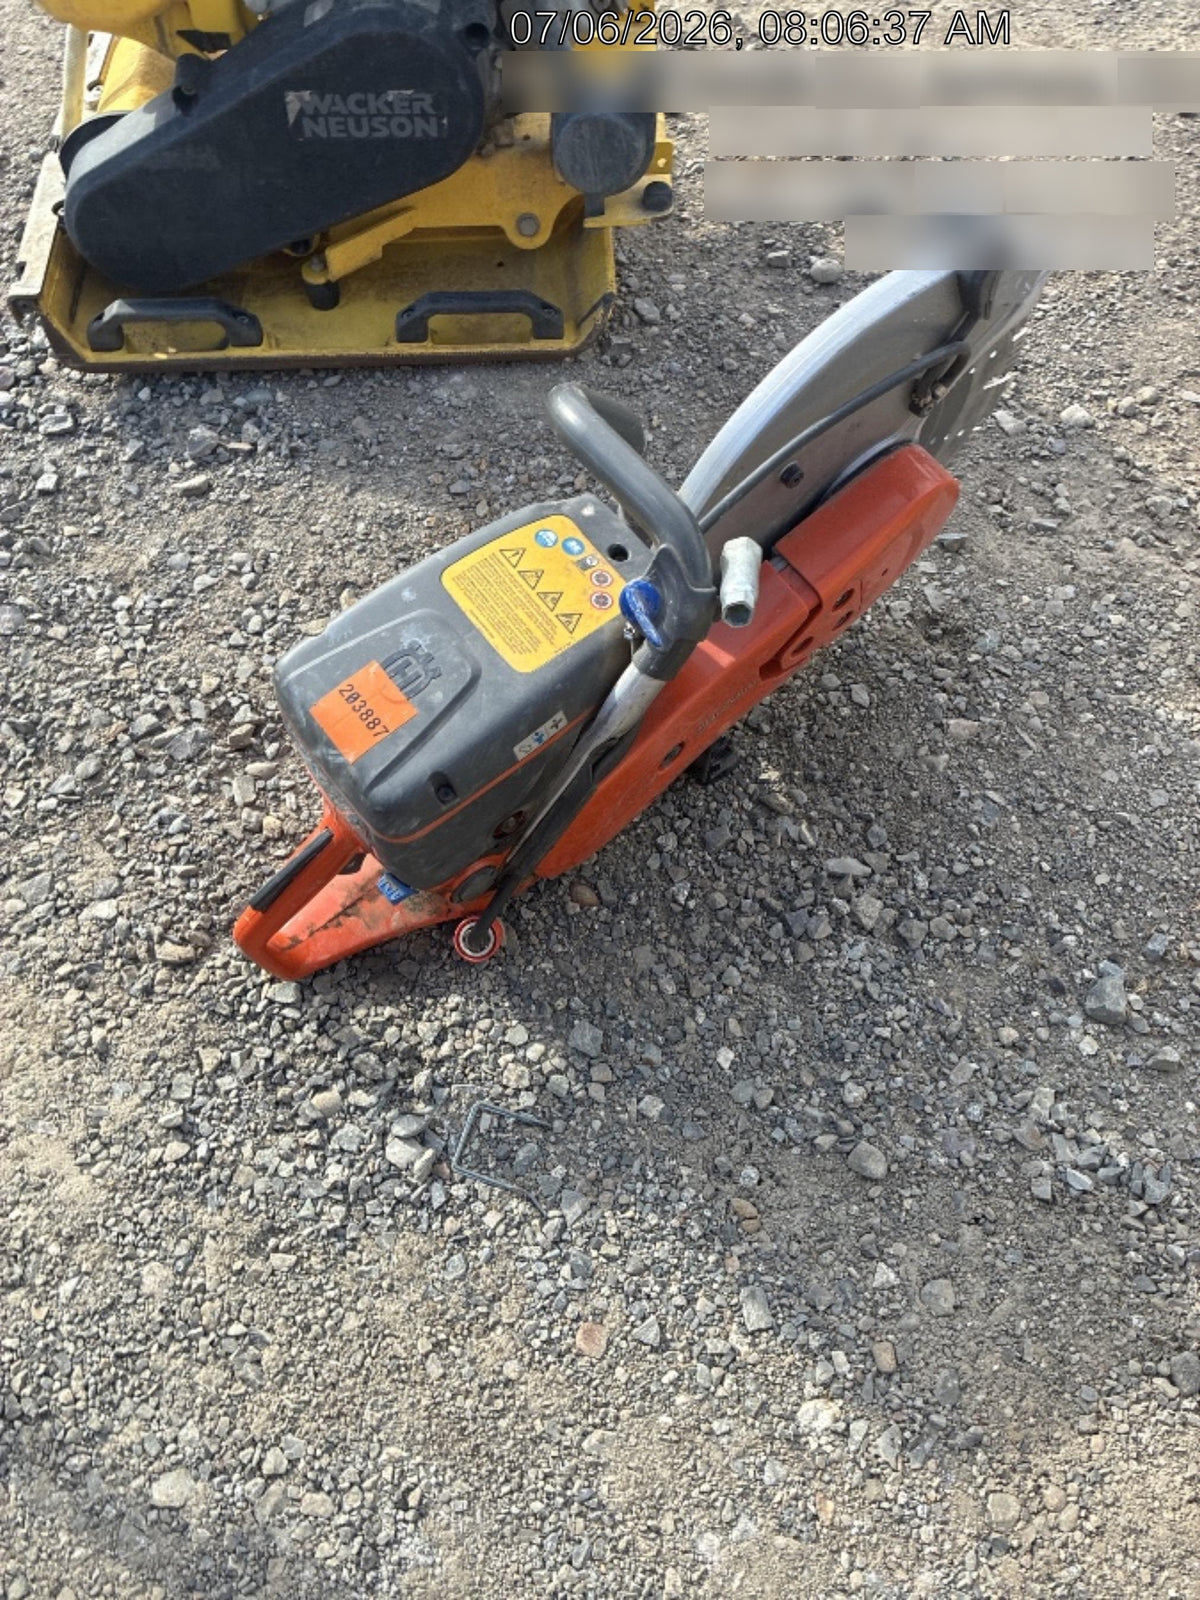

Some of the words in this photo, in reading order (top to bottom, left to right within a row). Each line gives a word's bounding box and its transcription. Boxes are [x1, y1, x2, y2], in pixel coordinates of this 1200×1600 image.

[302, 92, 436, 115] WACKER
[302, 116, 438, 138] NEUSON
[338, 684, 390, 737] 203887
